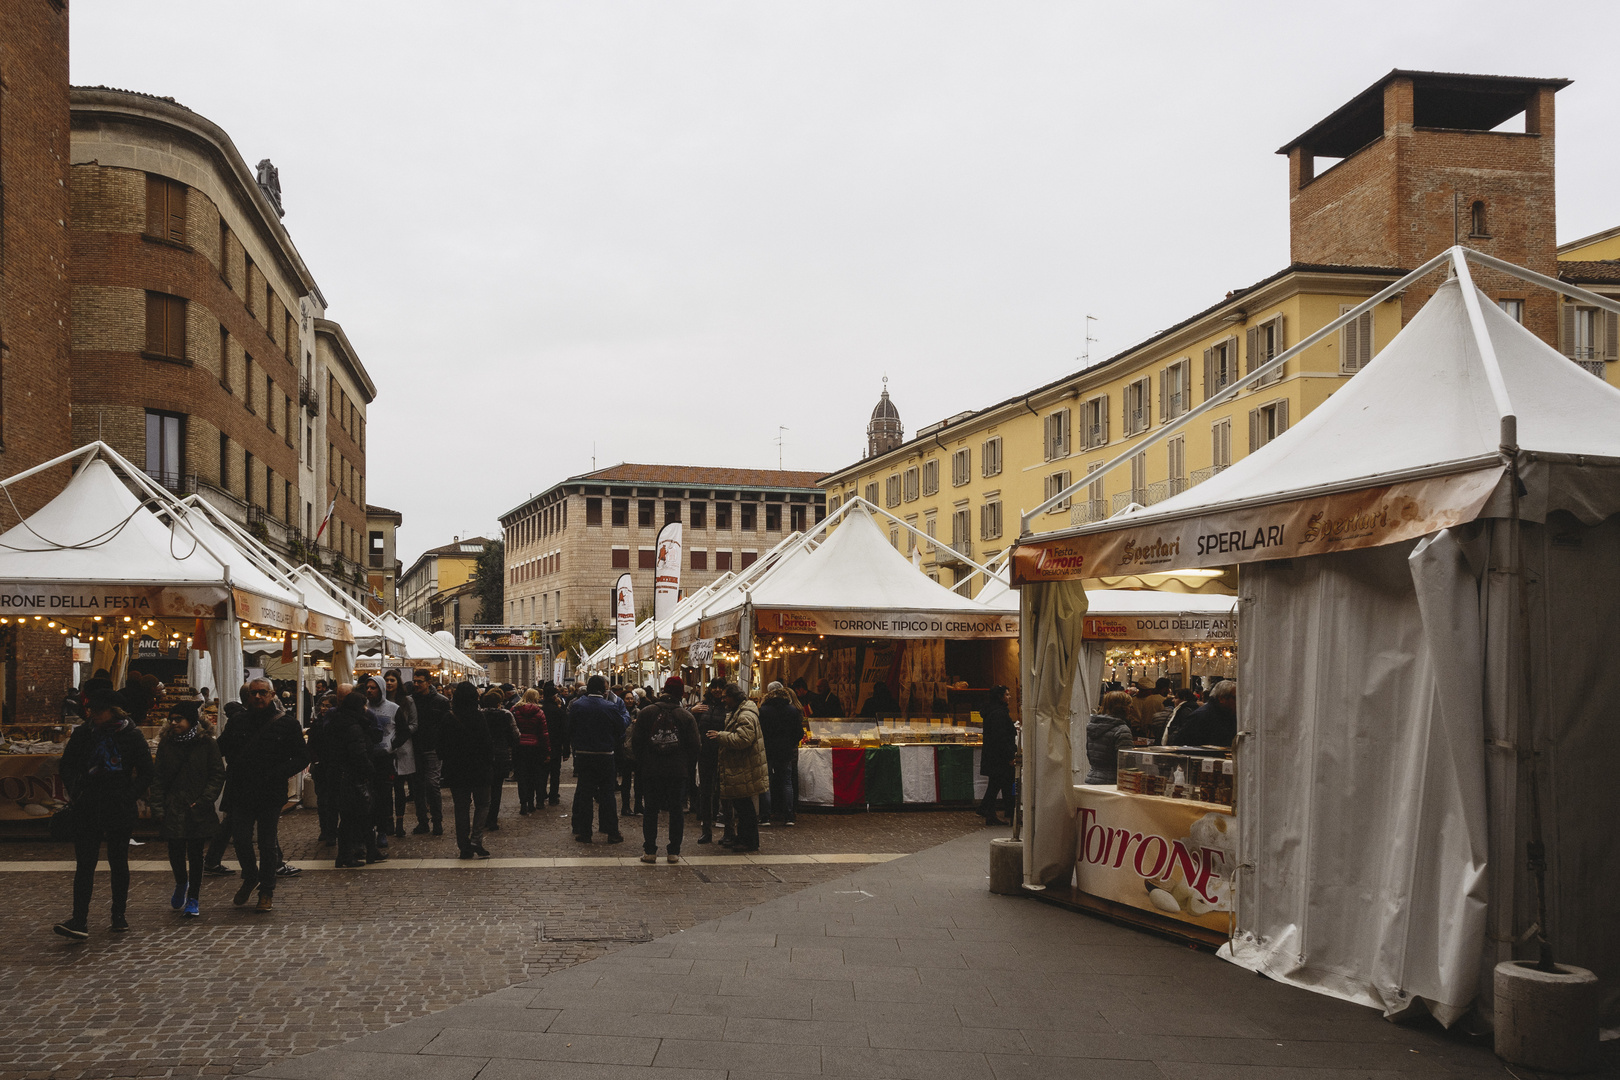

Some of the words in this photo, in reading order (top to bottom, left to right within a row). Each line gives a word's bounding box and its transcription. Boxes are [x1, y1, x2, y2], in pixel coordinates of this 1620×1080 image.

[1298, 504, 1390, 545] Sperlari
[1197, 524, 1286, 556] SPERLARI
[1054, 548, 1073, 557] Festa
[1117, 535, 1181, 566] Sperlari
[1032, 547, 1083, 575] Torrone
[50, 595, 99, 609] DELLA
[104, 596, 151, 609] FESTA
[772, 612, 817, 630] Torrone
[833, 619, 889, 631] TORRONE
[890, 620, 928, 632] TIPICO
[931, 621, 943, 632] DI
[945, 621, 1002, 633] CREMONA
[1086, 619, 1127, 635] Torrone
[1137, 620, 1168, 630] DOLCI
[1171, 619, 1210, 630] DELIZIE
